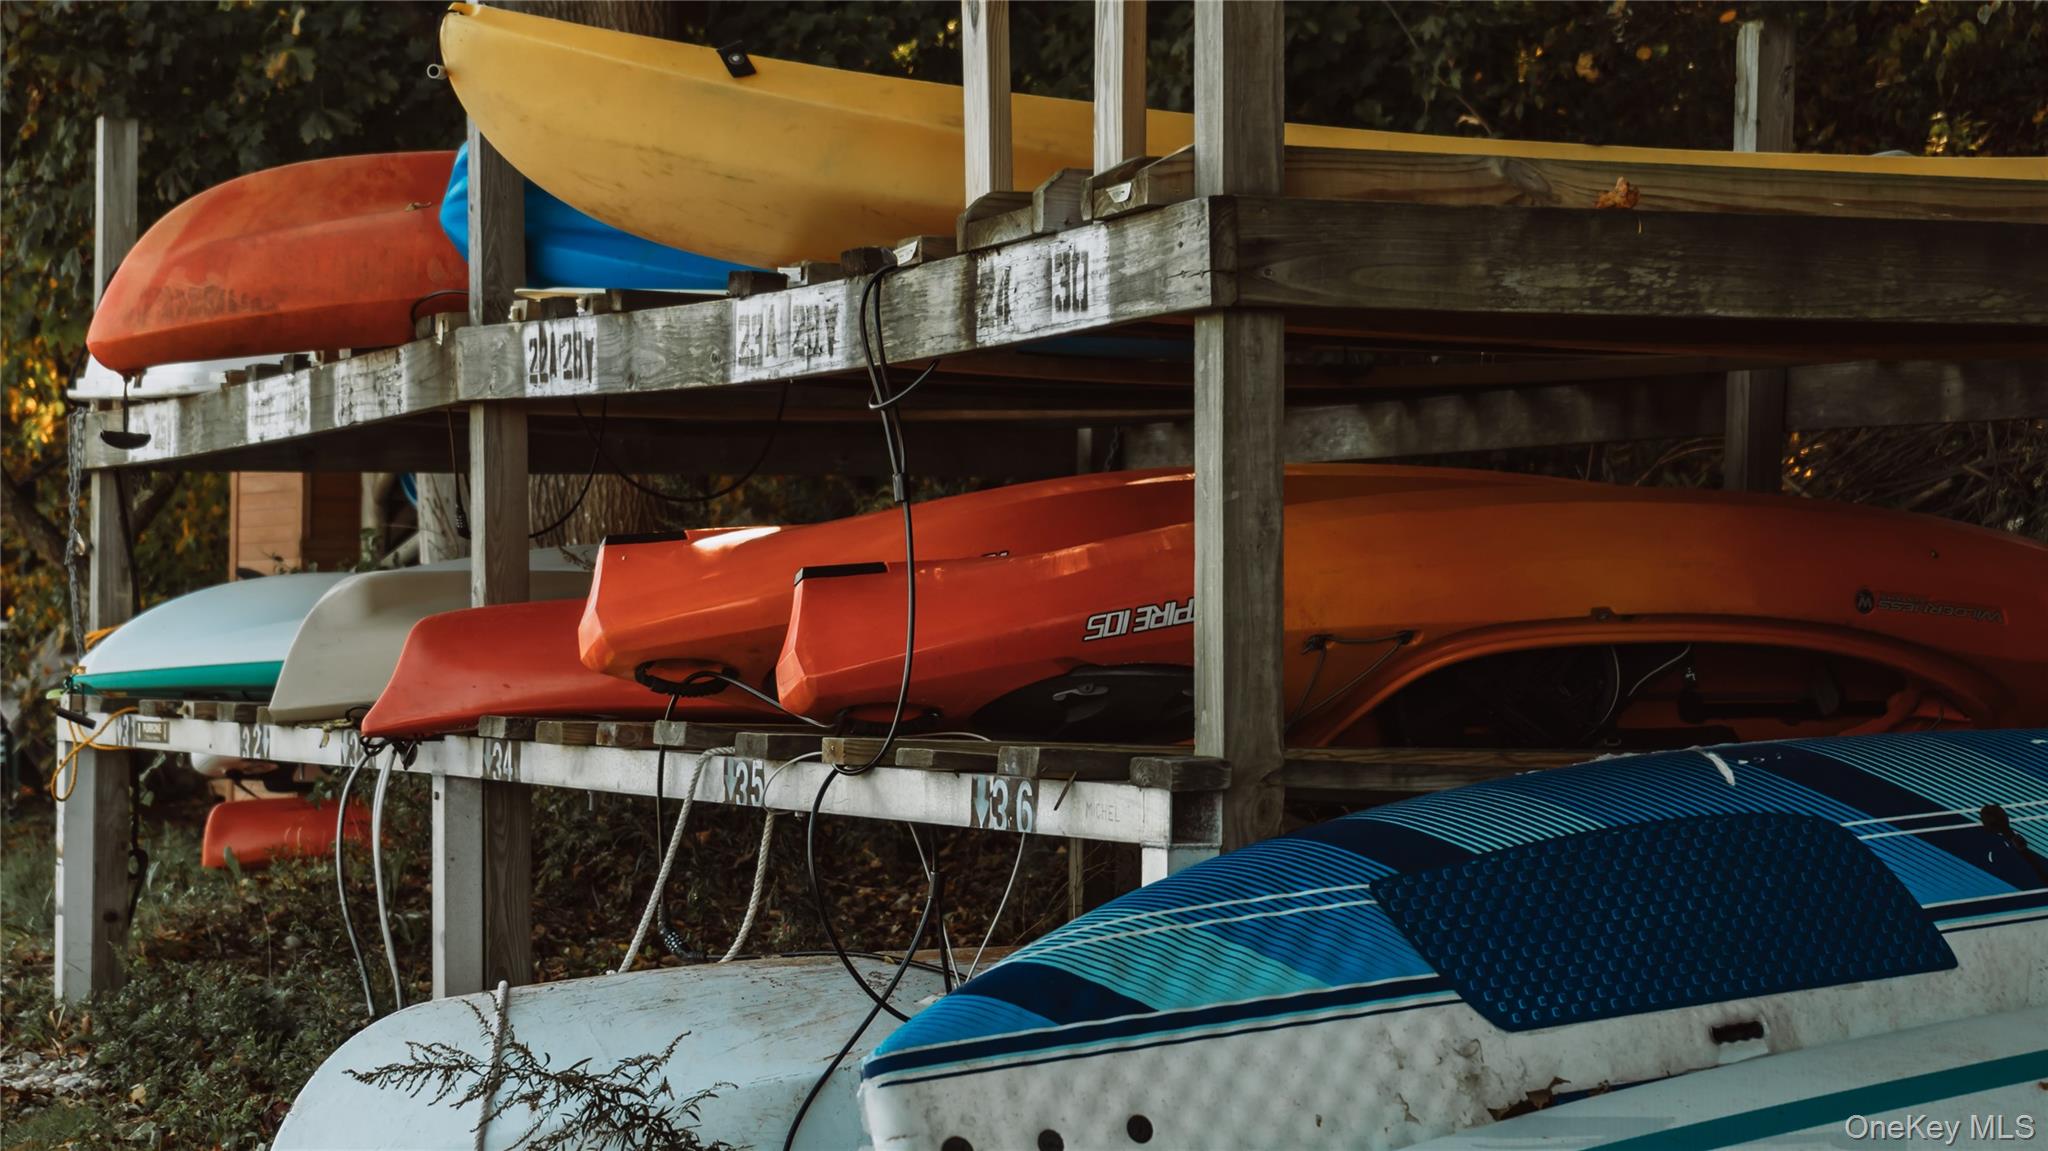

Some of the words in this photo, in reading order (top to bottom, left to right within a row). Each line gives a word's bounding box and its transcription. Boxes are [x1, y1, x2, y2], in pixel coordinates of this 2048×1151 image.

[1053, 251, 1089, 313] 30
[1083, 609, 1131, 642] 105
[242, 723, 261, 759] 32
[492, 740, 513, 782] 34
[735, 759, 764, 807] 35
[992, 779, 1033, 833] 36
